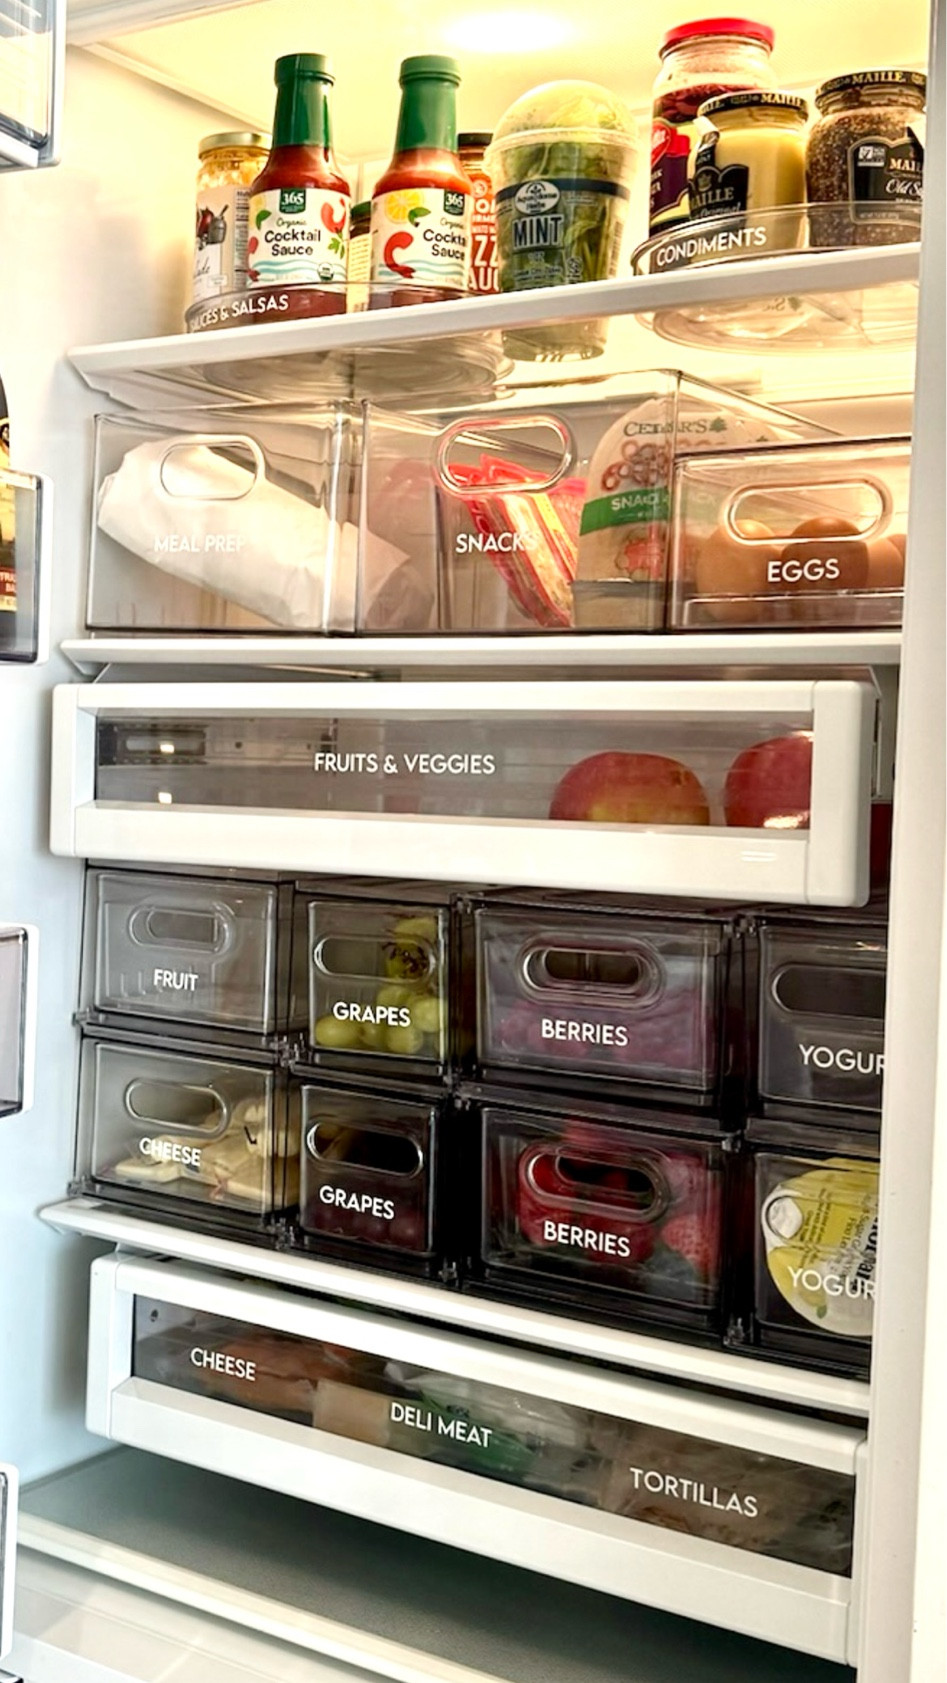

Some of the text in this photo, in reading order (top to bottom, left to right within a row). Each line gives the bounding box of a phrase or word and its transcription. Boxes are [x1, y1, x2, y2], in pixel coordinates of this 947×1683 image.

[281, 191, 305, 206] 365
[264, 229, 321, 243] Cocktail
[423, 228, 467, 247] Cockta
[513, 215, 563, 249] MINT
[271, 243, 314, 257] Sauce
[656, 226, 767, 267] CONDIMENTS
[220, 304, 229, 321] &
[231, 294, 289, 318] SALSAS
[153, 533, 246, 553] MEAL PREP
[455, 531, 537, 553] SNACKS
[768, 558, 840, 582] EGGS
[314, 752, 496, 775] FRUITS & VEGGIES
[153, 968, 199, 992] FRUIT
[333, 1001, 411, 1027] GRAPES
[541, 1018, 628, 1048] BERRIES
[798, 1043, 885, 1076] YOGUR
[139, 1136, 201, 1167] CHEESE
[319, 1184, 395, 1220] GRAPES
[544, 1220, 630, 1257] BERRIES
[787, 1265, 877, 1300] YOGUR
[190, 1347, 256, 1382] CHEESE
[391, 1402, 492, 1448] DELI MEAT
[630, 1467, 758, 1517] TORTILLAS
